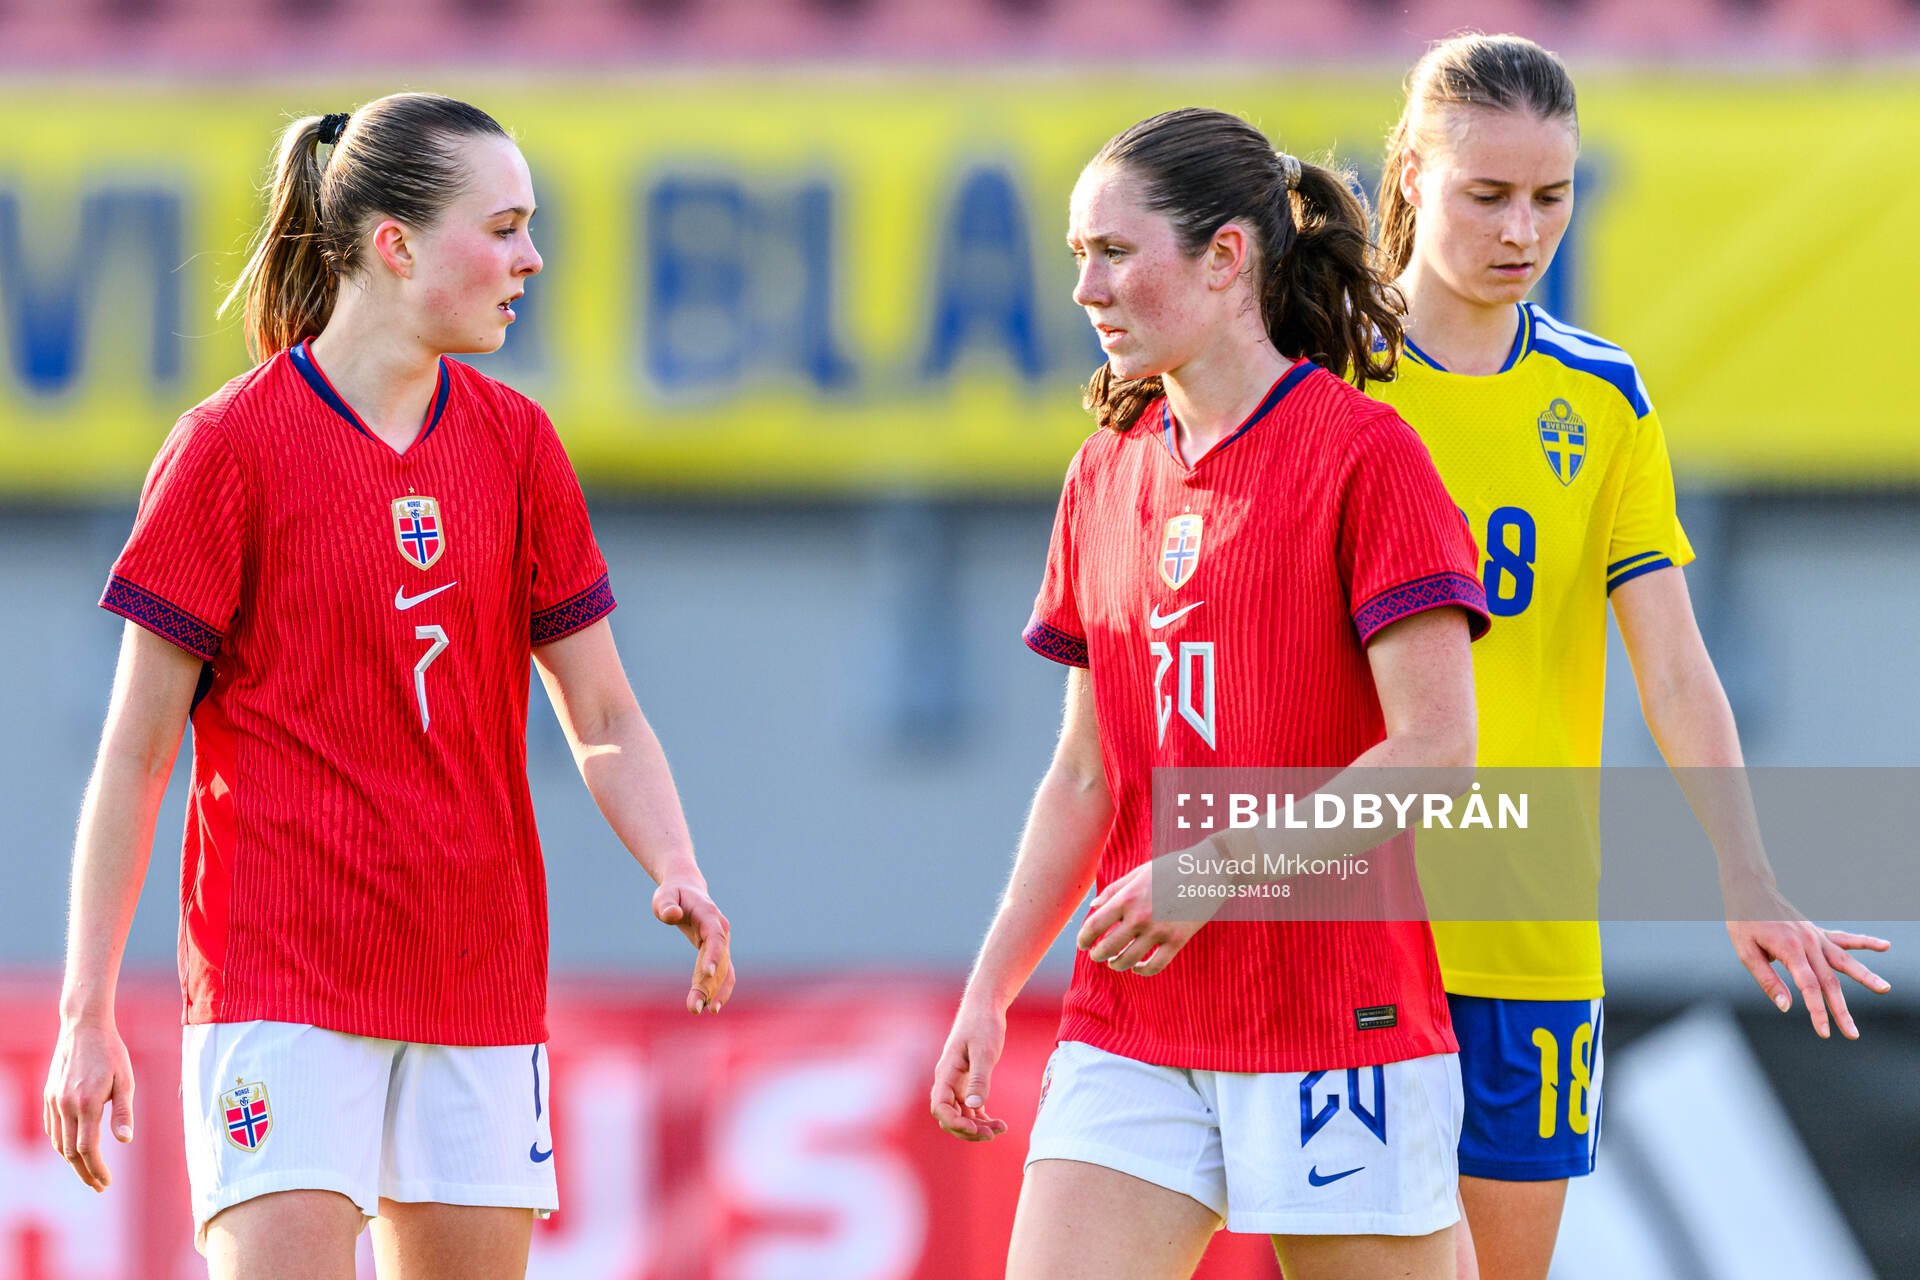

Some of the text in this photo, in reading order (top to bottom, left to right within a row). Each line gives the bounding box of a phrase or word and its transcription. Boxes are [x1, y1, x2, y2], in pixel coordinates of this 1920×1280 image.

[1459, 506, 1536, 617] 8
[414, 624, 450, 734] 7
[1150, 642, 1216, 751] 20
[1300, 1064, 1387, 1148] 20
[1532, 1022, 1592, 1138] 18
